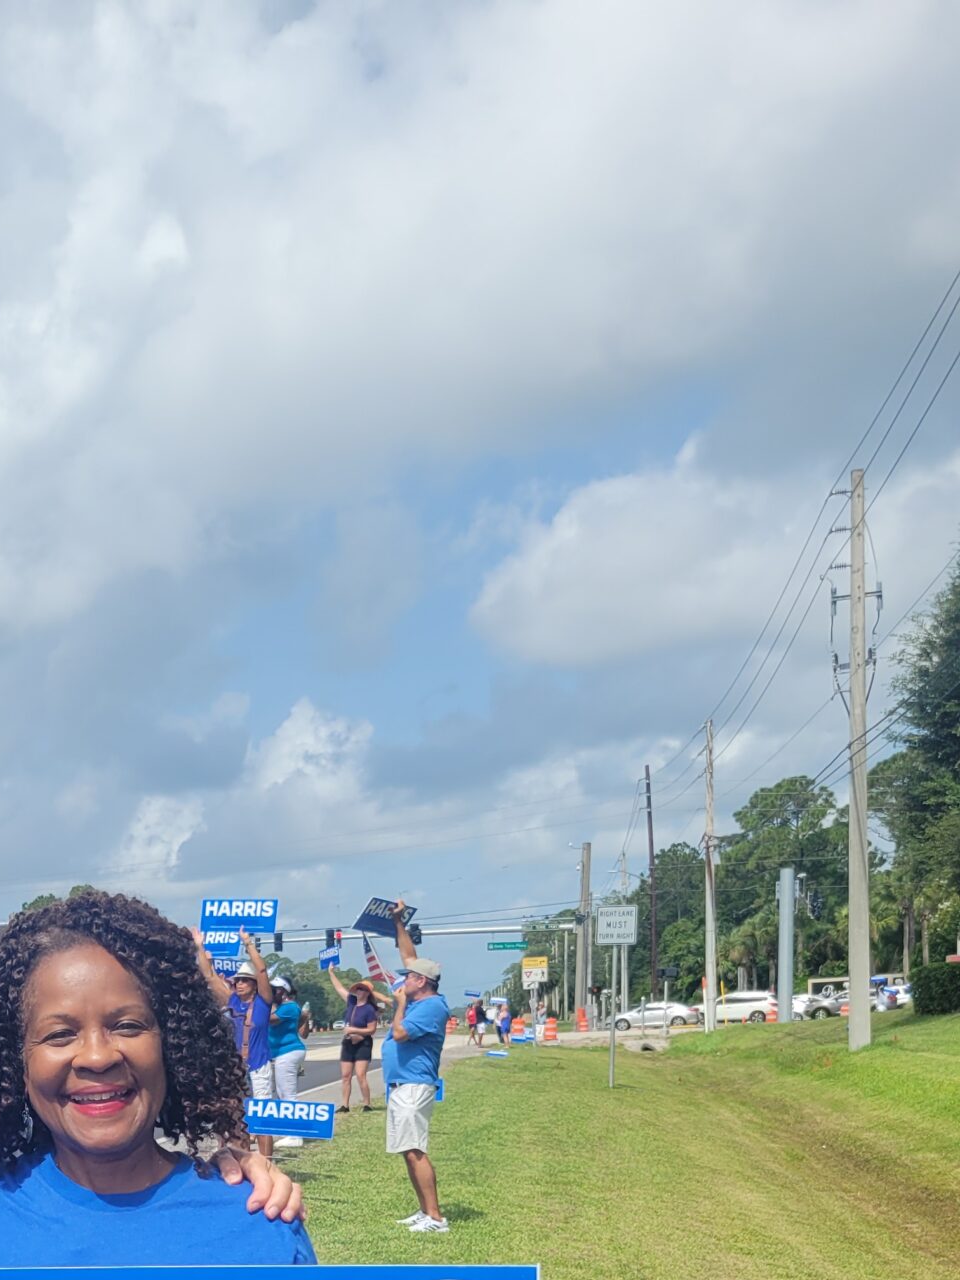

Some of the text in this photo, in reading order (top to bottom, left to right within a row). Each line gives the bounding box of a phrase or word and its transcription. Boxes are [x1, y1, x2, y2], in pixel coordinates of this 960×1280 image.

[205, 901, 274, 917] HARRIS
[365, 900, 414, 923] HARS
[247, 1100, 329, 1121] HARRIS
